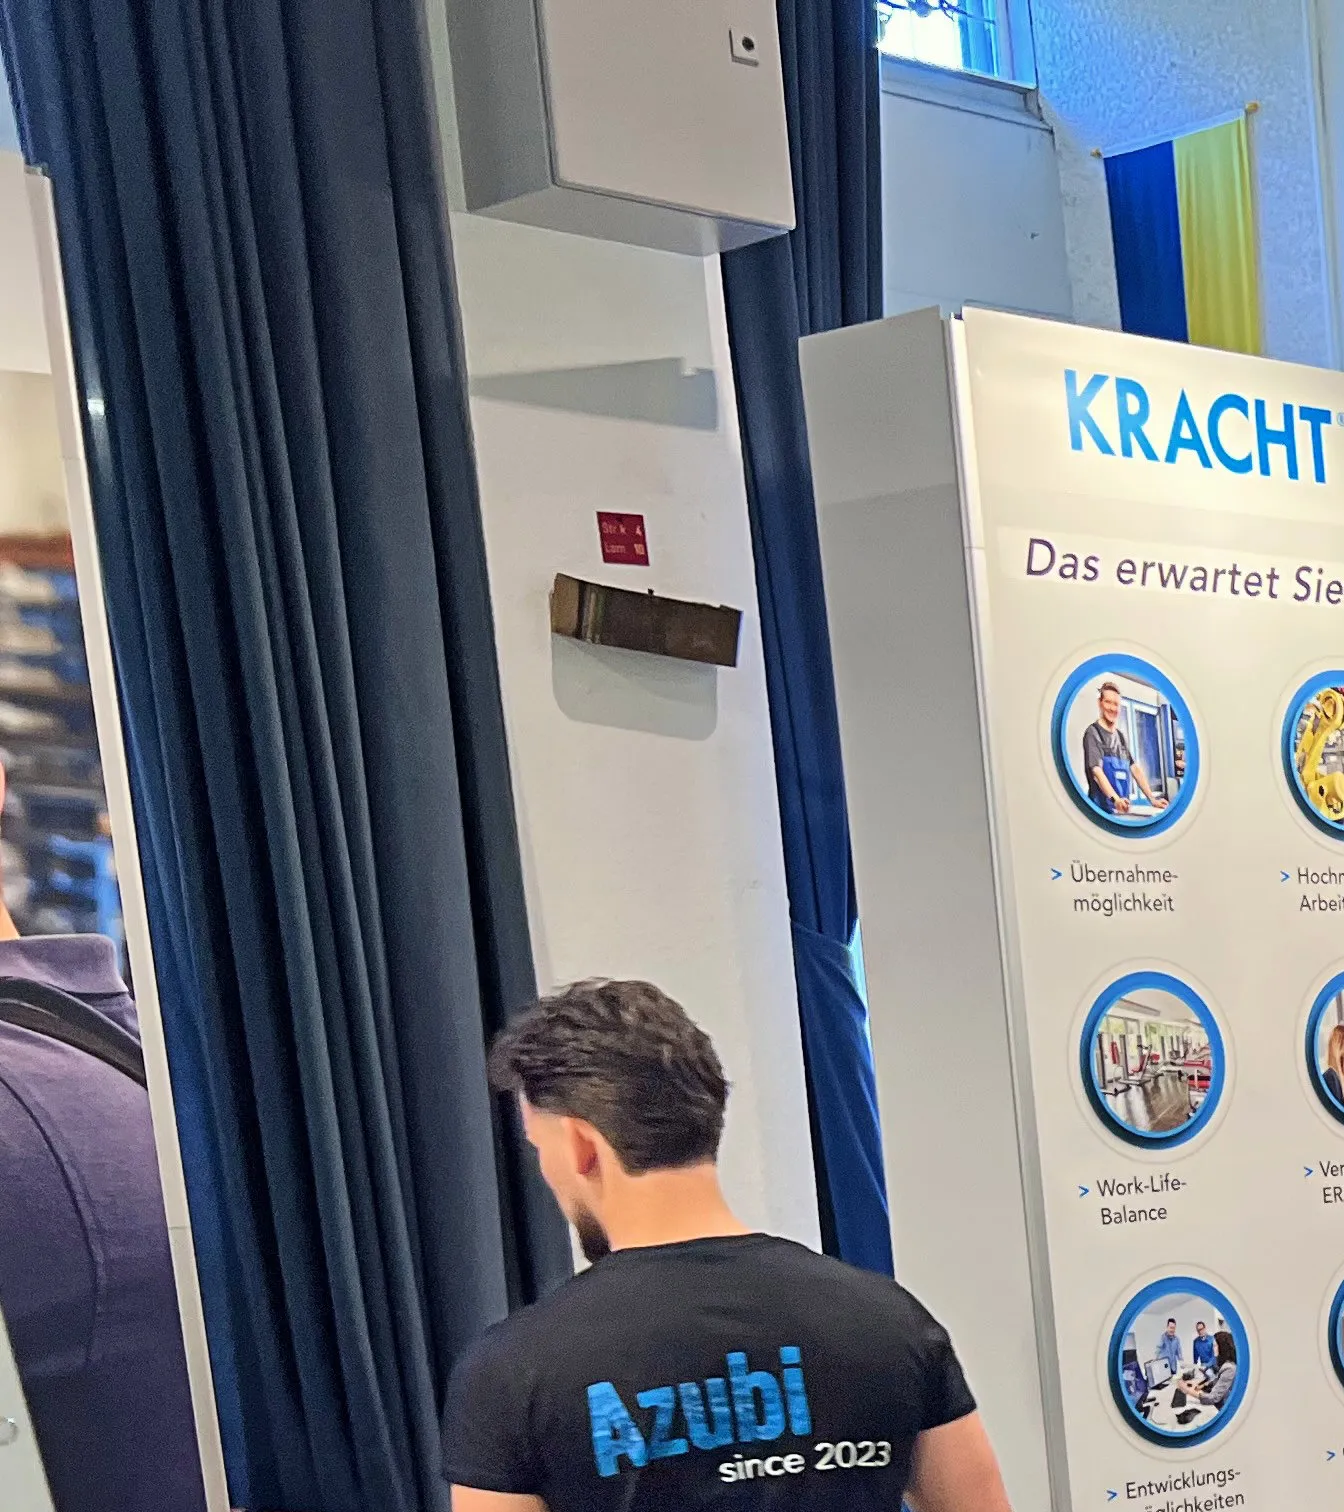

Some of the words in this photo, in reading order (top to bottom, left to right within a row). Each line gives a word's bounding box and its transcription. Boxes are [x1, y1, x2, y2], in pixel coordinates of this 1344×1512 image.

[1025, 538, 1099, 581] Das
[1116, 556, 1279, 600] erwartet
[1293, 566, 1344, 605] Sie
[1070, 860, 1179, 884] Übernahme-
[1073, 892, 1175, 918] möglichkeit
[1097, 1173, 1187, 1198] Work-Life-
[1100, 1204, 1168, 1227] Balance
[586, 1346, 813, 1478] Azubi
[719, 1452, 806, 1484] since
[814, 1440, 892, 1472] 2023
[1125, 1465, 1241, 1501] Entwicklungs-
